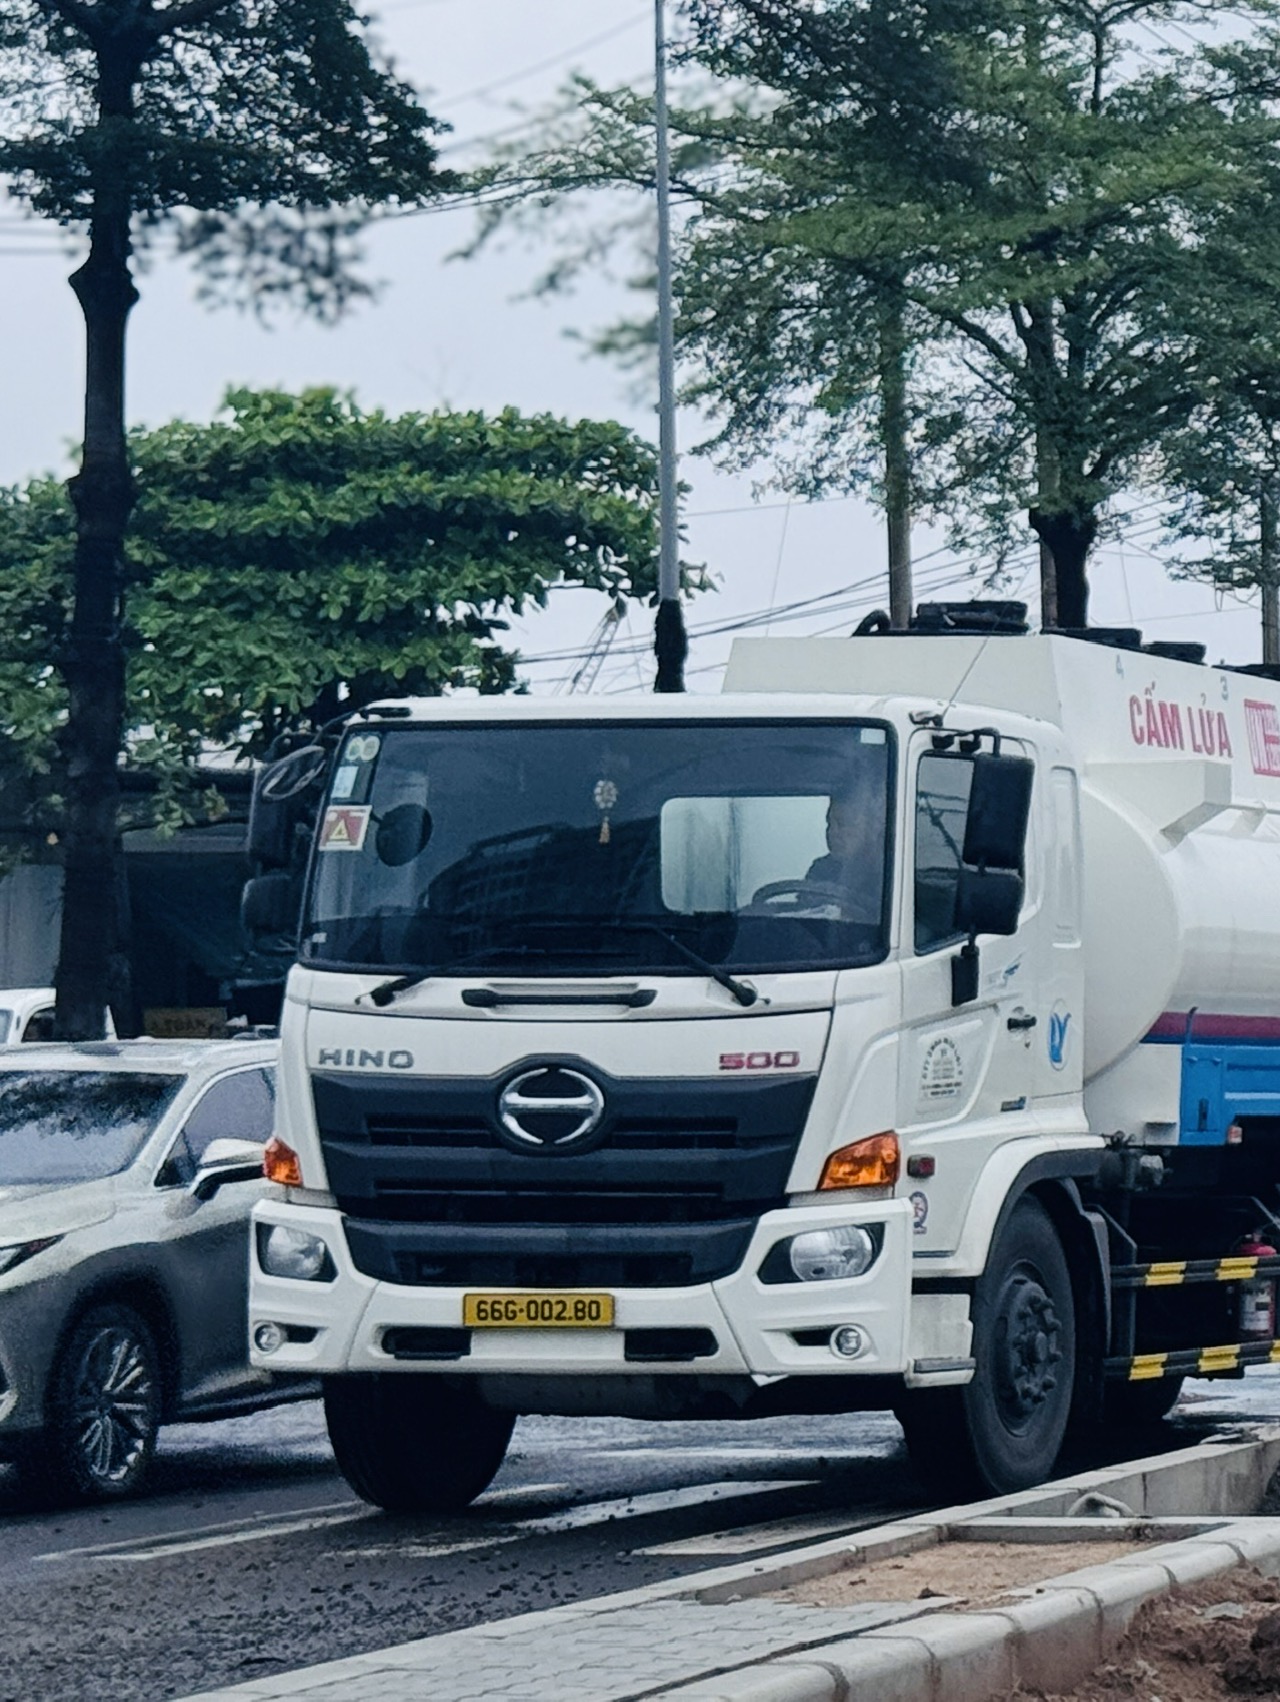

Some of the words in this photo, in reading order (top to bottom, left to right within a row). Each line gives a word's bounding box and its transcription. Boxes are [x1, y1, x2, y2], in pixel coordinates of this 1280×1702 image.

[1129, 680, 1185, 751] CẤM
[319, 1048, 414, 1069] HINO
[718, 1051, 801, 1070] 500
